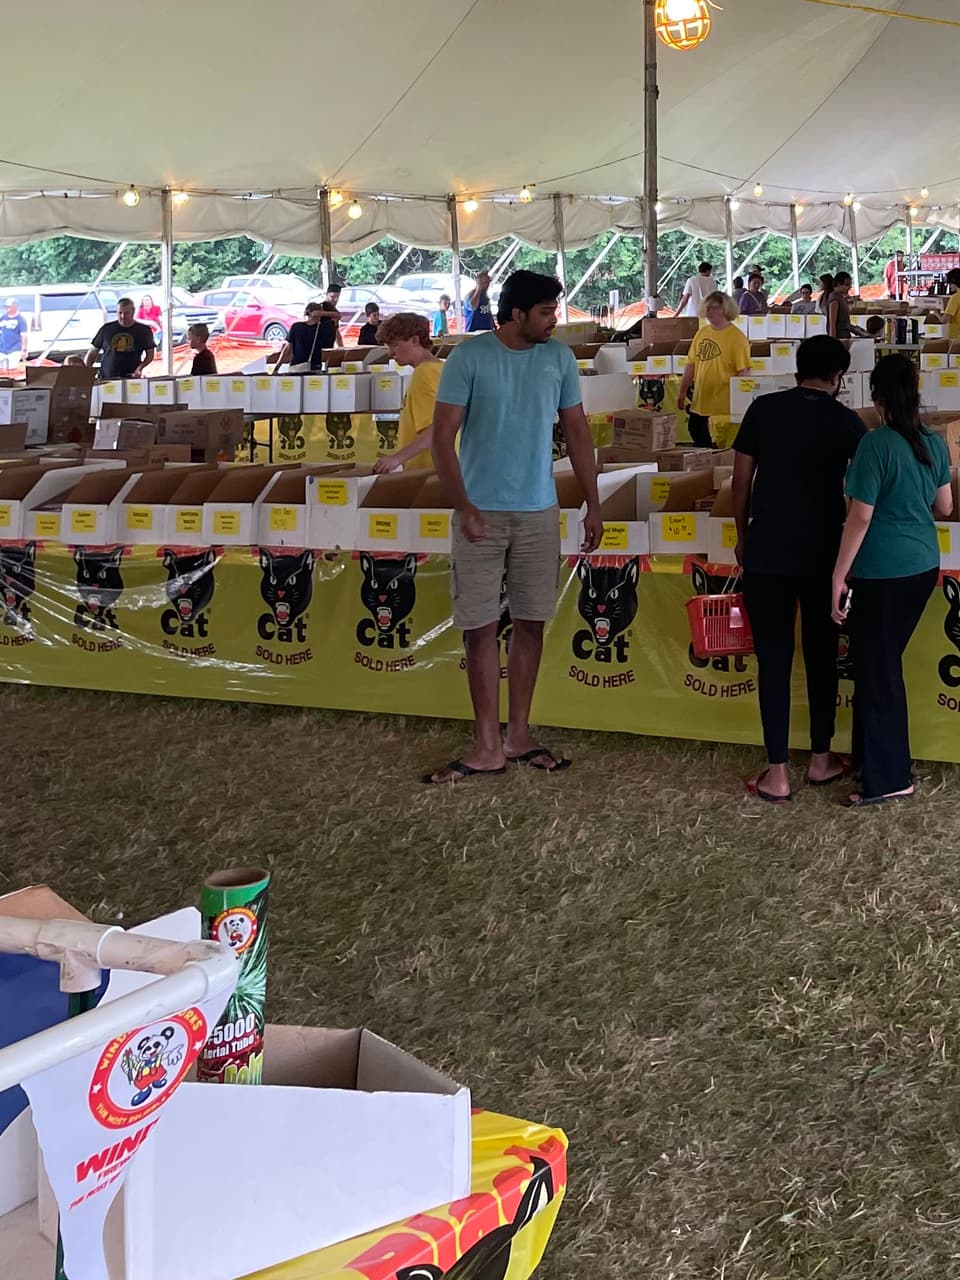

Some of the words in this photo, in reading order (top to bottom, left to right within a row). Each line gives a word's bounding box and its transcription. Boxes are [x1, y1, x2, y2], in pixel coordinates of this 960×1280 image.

[74, 604, 119, 631] Cat
[160, 608, 209, 638] Cat
[257, 613, 307, 643] Cat
[72, 634, 96, 653] SOLD
[97, 637, 124, 653] HERE
[356, 618, 410, 649] Cat
[162, 640, 189, 658] SOLD
[190, 643, 216, 658] HERE
[256, 645, 284, 665] SOLD
[286, 648, 313, 665] HERE
[572, 629, 630, 664] Cat
[354, 652, 384, 672] SOLD
[386, 655, 416, 673] HERE
[569, 665, 600, 689] SOLD
[603, 669, 636, 689] HERE
[684, 674, 718, 698] SOLD
[720, 679, 757, 698] HERE
